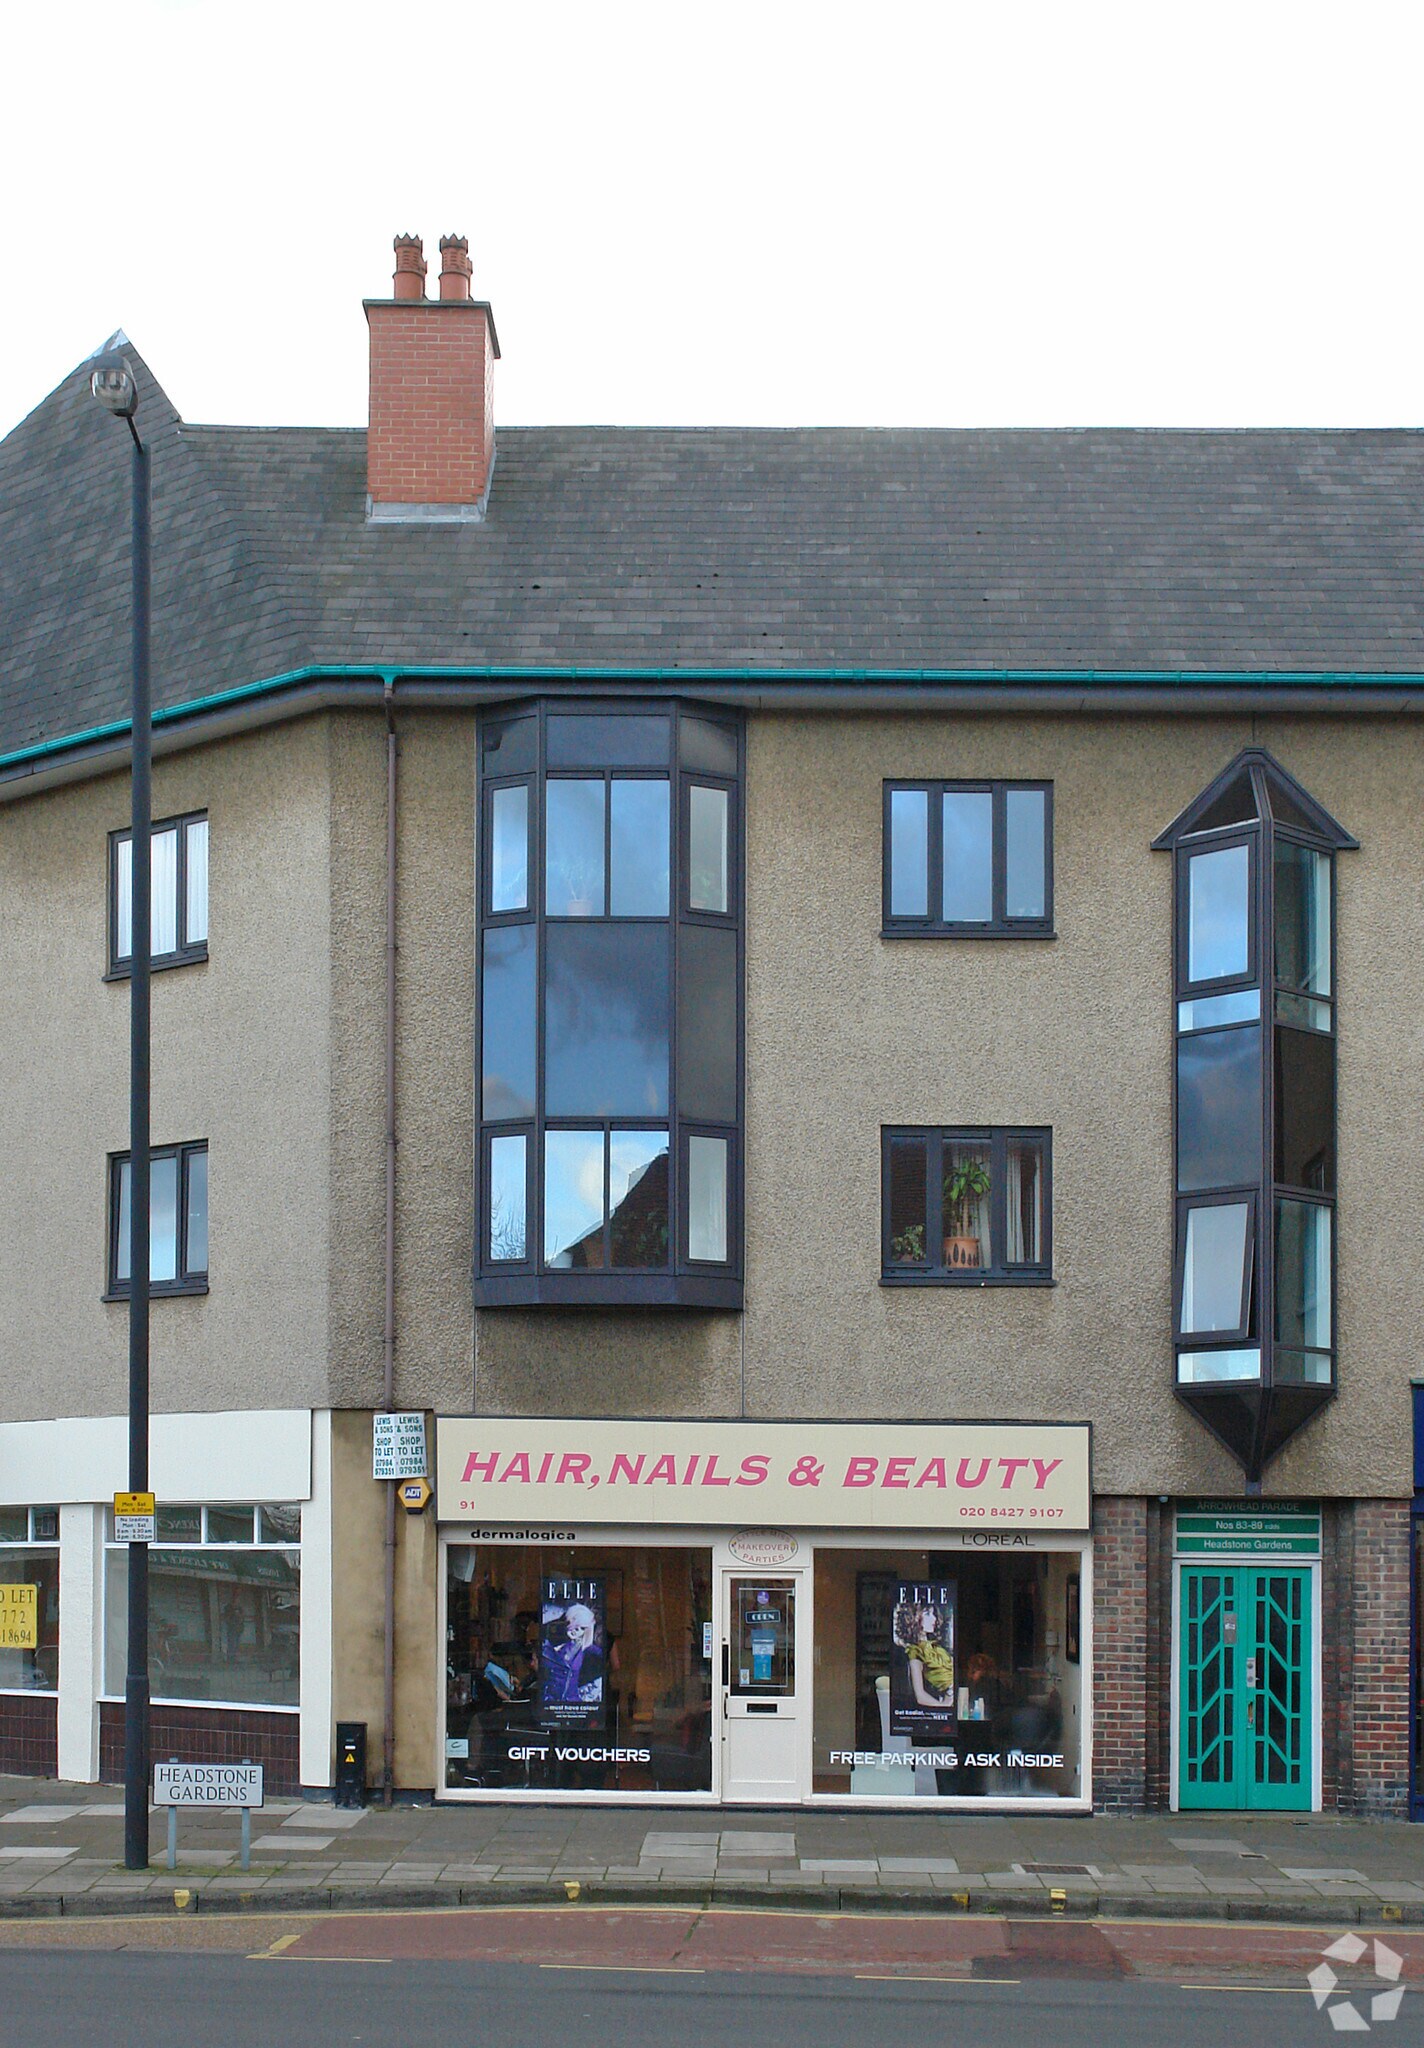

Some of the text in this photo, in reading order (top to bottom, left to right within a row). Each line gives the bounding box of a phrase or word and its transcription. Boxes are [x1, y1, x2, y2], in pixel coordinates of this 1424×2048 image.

[376, 1438, 391, 1446] SHOP
[400, 1436, 420, 1445] SHOP
[398, 1446, 424, 1455] TO LET
[787, 1455, 825, 1487] &
[842, 1456, 1064, 1490] BEAUTY
[405, 1488, 421, 1498] ADT
[460, 1501, 474, 1510] 91
[1197, 1502, 1300, 1512] ARROWHEAD PARADE
[960, 1508, 1064, 1517] 020 8427 9107
[1216, 1521, 1234, 1529] Nos
[1236, 1521, 1263, 1530] 83-89
[471, 1530, 575, 1540] dermalogica
[1204, 1540, 1292, 1550] Headstone Gardens
[743, 1554, 784, 1563] PARTIES
[549, 1582, 596, 1599] ELLE
[900, 1587, 947, 1604] ELLE
[11, 1590, 33, 1603] LET
[508, 1746, 650, 1762] GIFT VOUCHERS
[830, 1752, 1064, 1768] FREE PARKING ASK INSIDE
[160, 1768, 257, 1784] HEADSTONE
[170, 1786, 247, 1801] GARDENS
